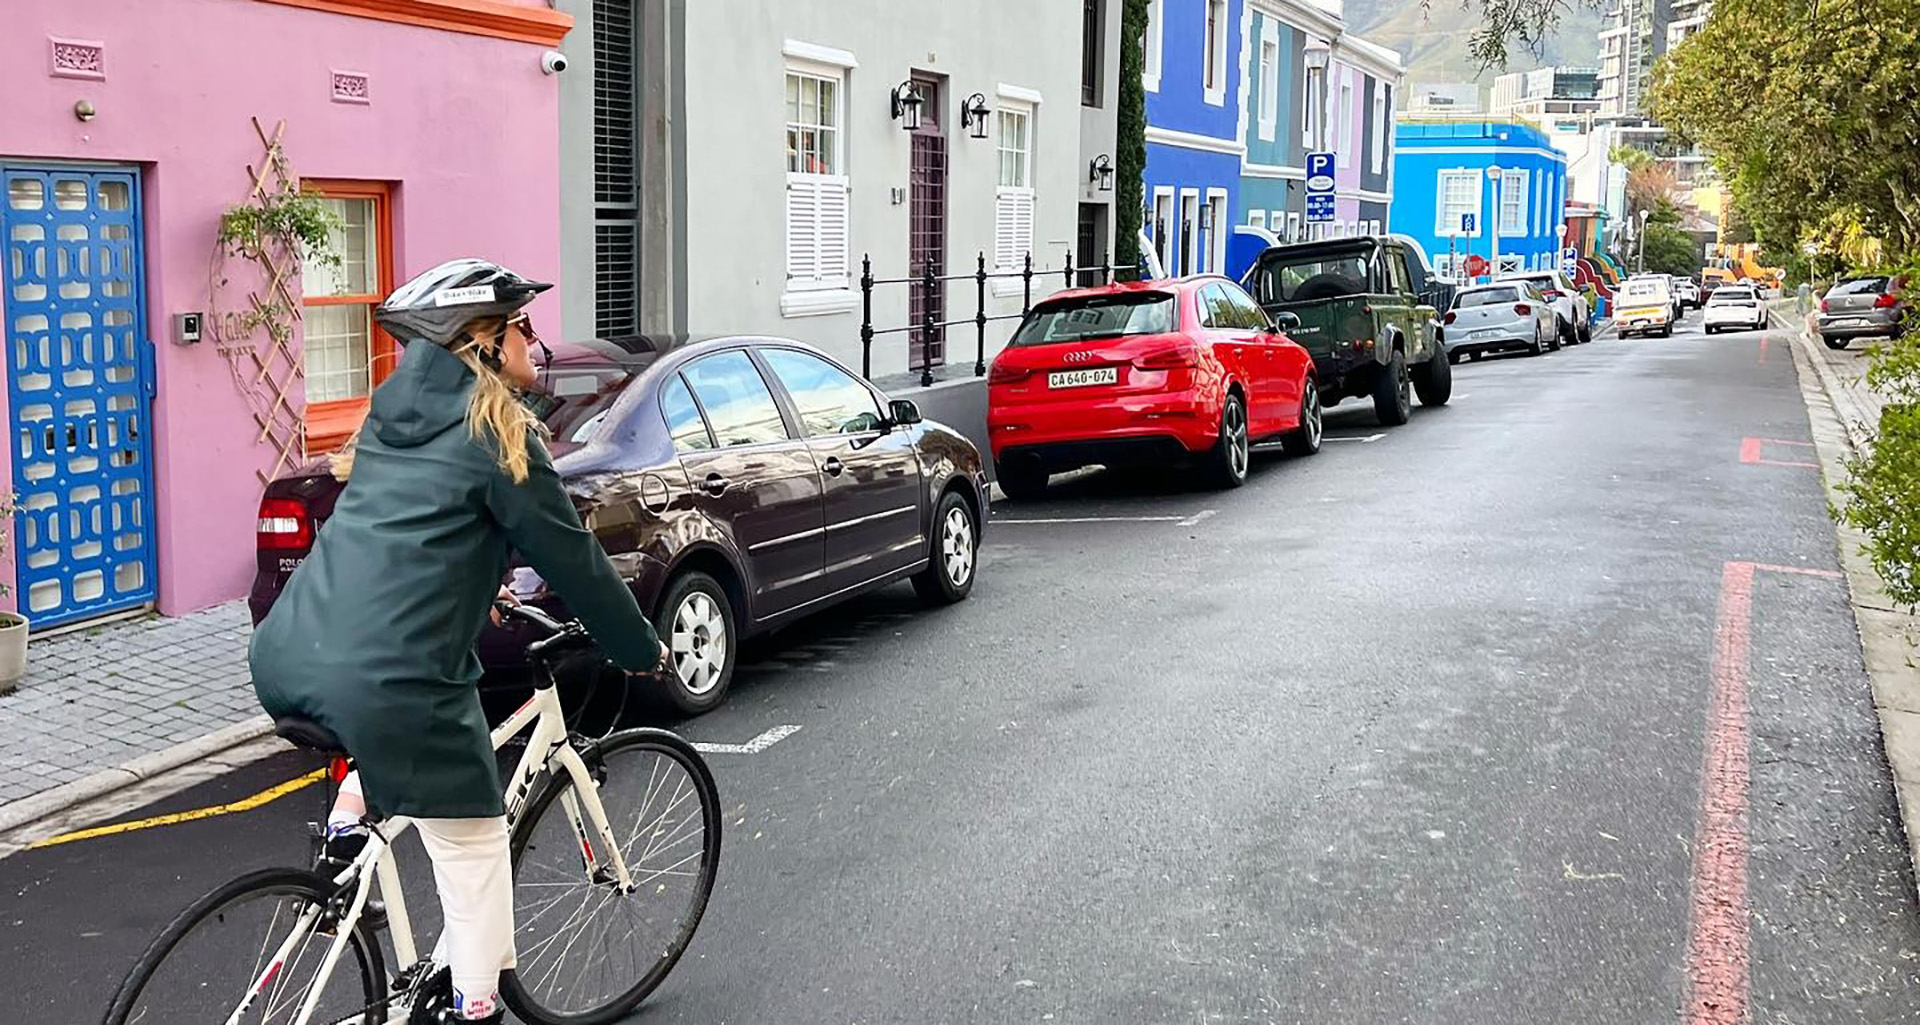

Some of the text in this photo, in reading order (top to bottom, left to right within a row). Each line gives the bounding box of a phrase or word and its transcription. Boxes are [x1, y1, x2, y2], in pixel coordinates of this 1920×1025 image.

[1313, 156, 1328, 173] P
[1051, 370, 1114, 386] CA 640-074
[279, 558, 303, 567] POLO
